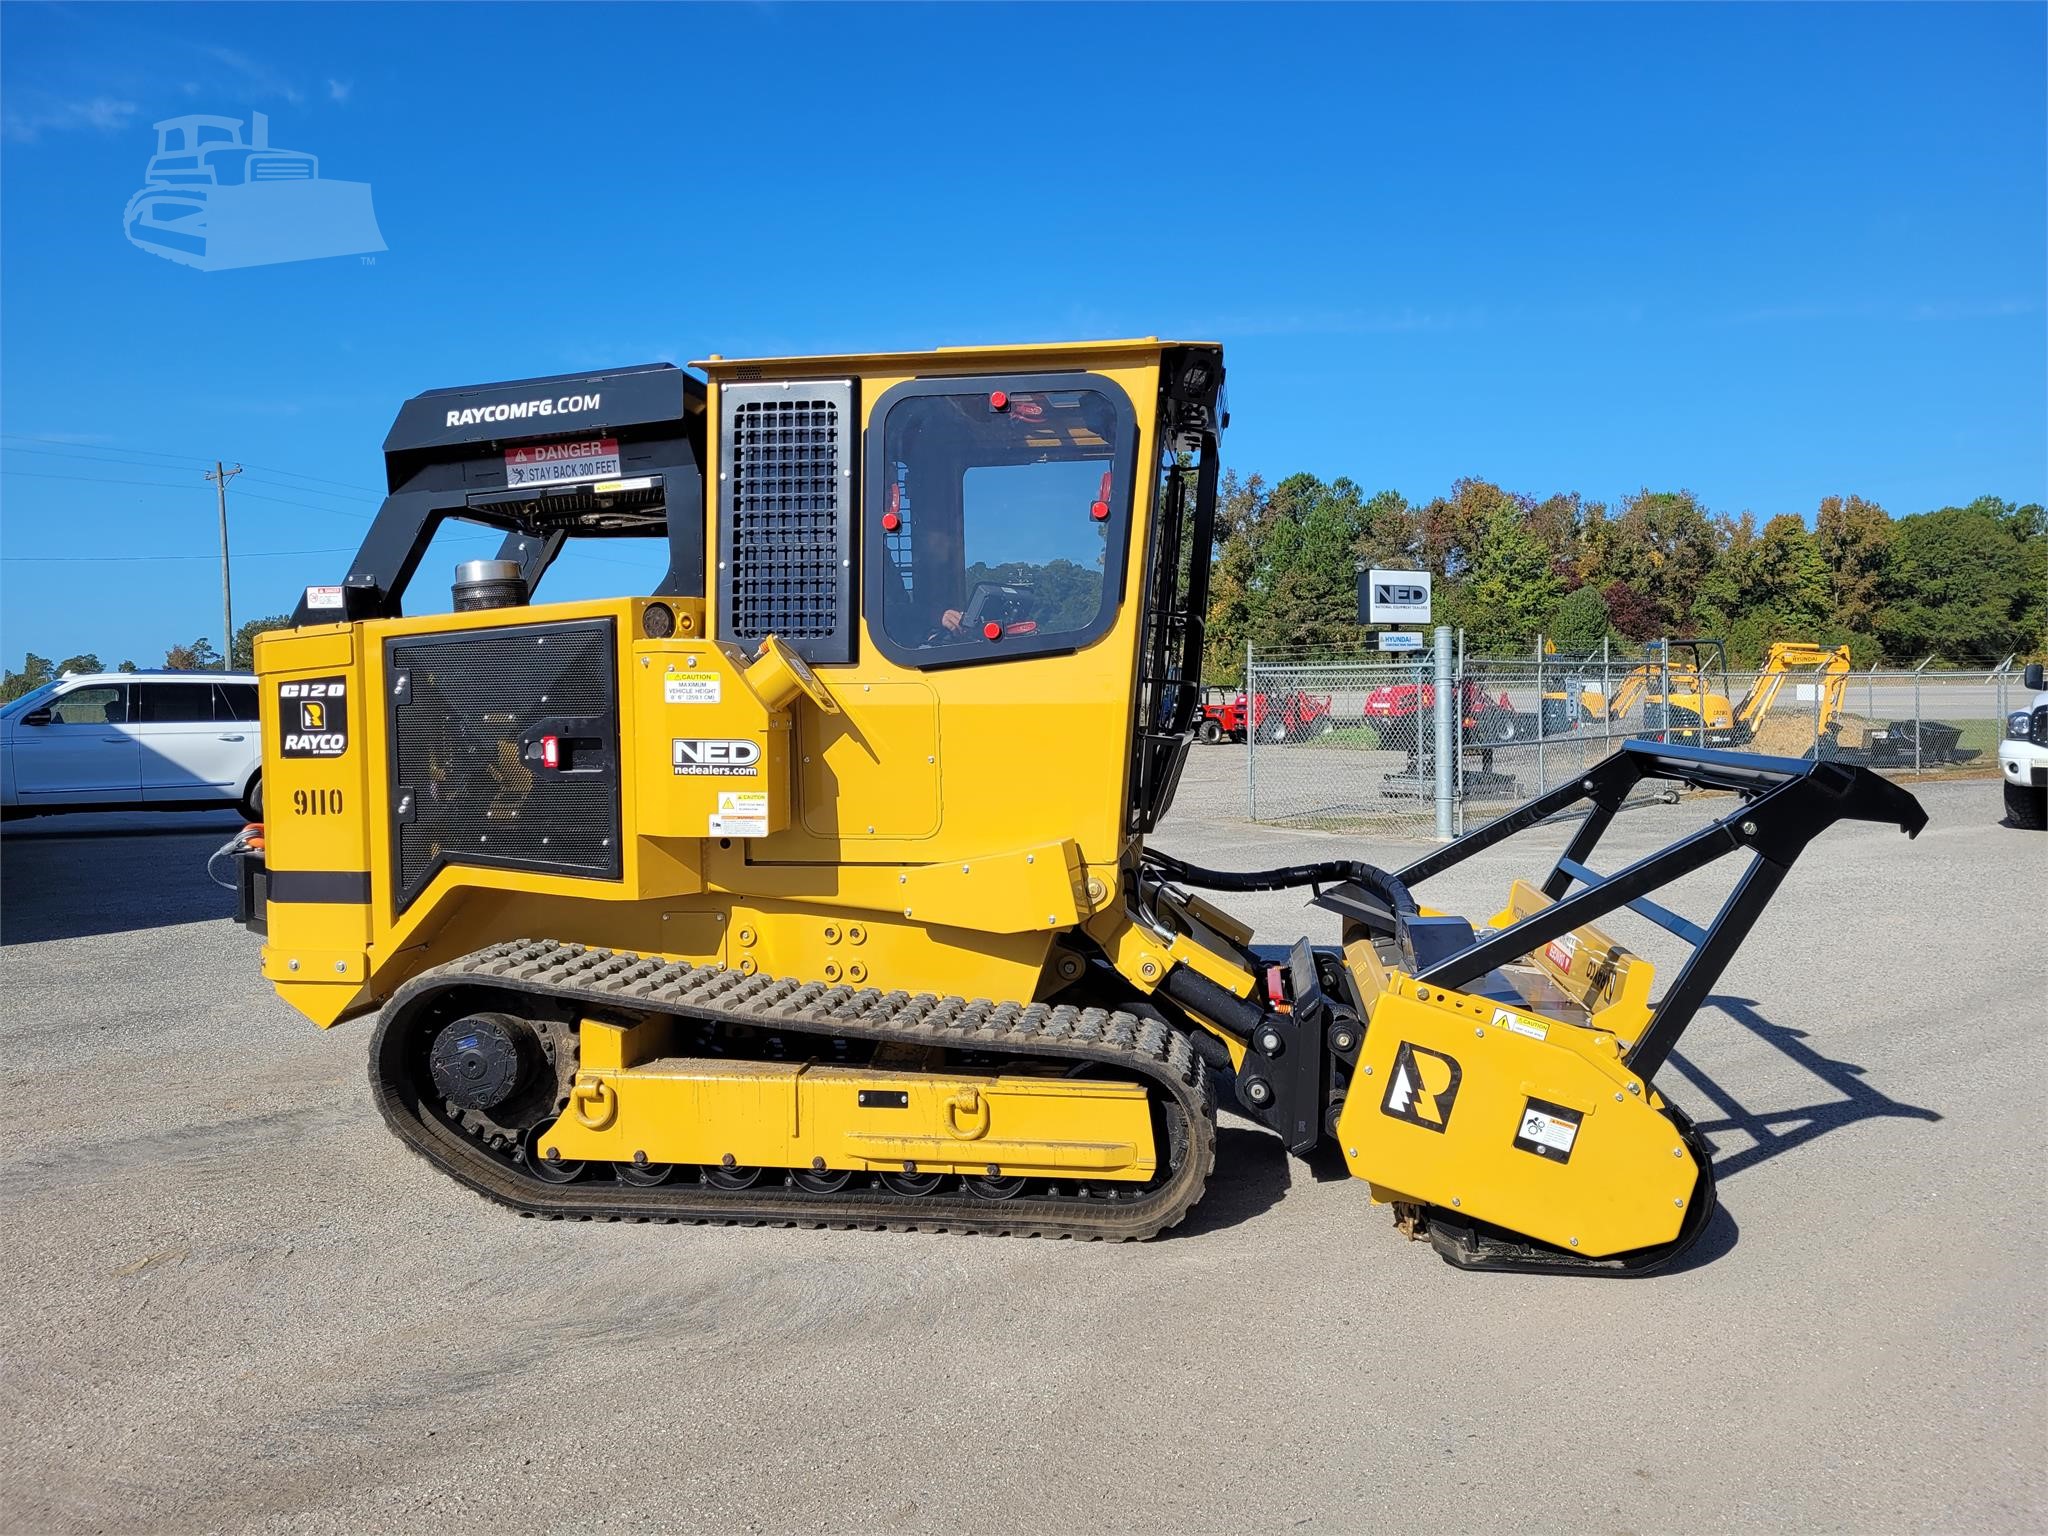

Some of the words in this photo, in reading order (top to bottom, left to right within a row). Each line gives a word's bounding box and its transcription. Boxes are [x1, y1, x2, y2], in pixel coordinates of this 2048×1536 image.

[446, 394, 601, 427] RAYCOMFG.COM
[535, 441, 602, 461] DANGER
[528, 467, 551, 481] STAY
[553, 464, 578, 479] BACK
[579, 462, 594, 476] 300
[595, 460, 617, 474] FEET
[1375, 584, 1428, 604] NED
[280, 684, 345, 698] C120
[285, 734, 345, 750] RAYCO
[674, 740, 759, 764] NED
[674, 765, 758, 776] nedealers.com
[293, 789, 343, 815] 9110
[1523, 1020, 1548, 1031] CAUTION
